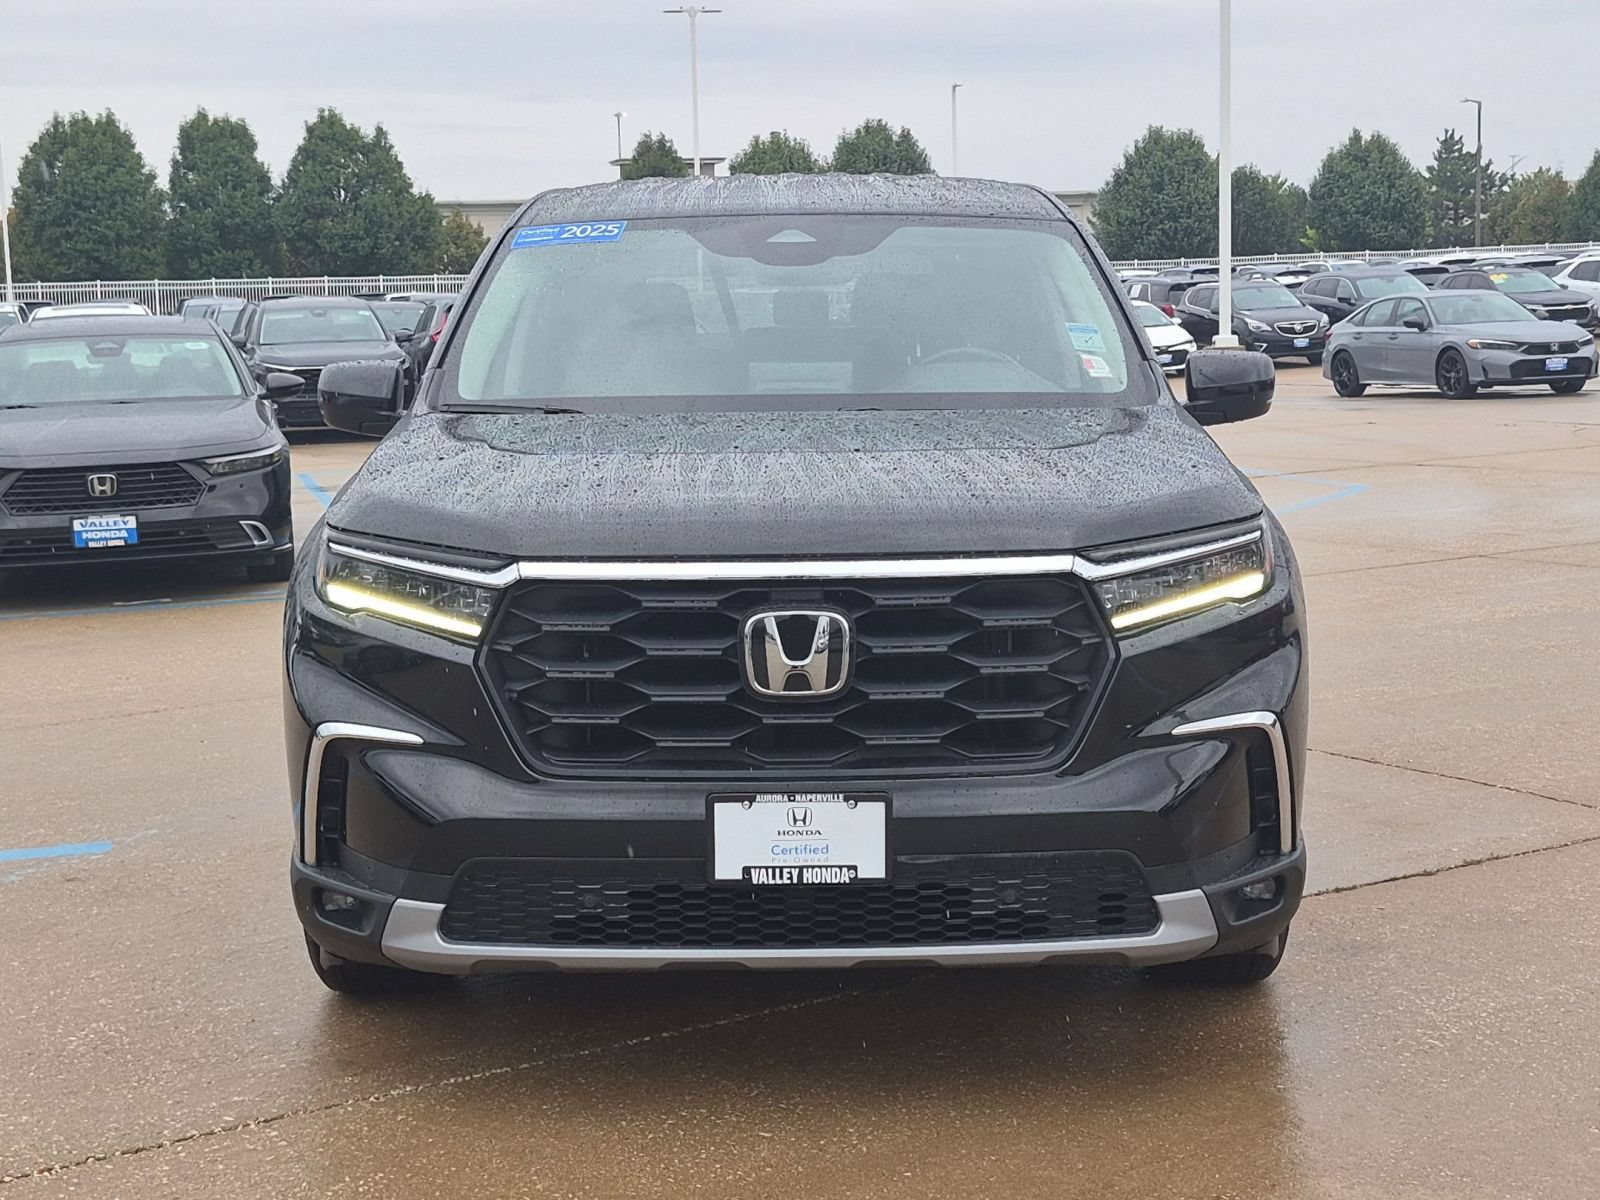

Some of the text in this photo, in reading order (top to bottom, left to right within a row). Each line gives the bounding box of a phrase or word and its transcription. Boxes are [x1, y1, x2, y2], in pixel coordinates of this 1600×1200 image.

[560, 223, 621, 238] 2025
[79, 520, 129, 528] VALLEY
[82, 530, 129, 540] HONDA
[755, 794, 844, 803] AURORA NAPERVILLE
[771, 844, 829, 856] Certified
[750, 868, 850, 885] VALLEY HONDA
